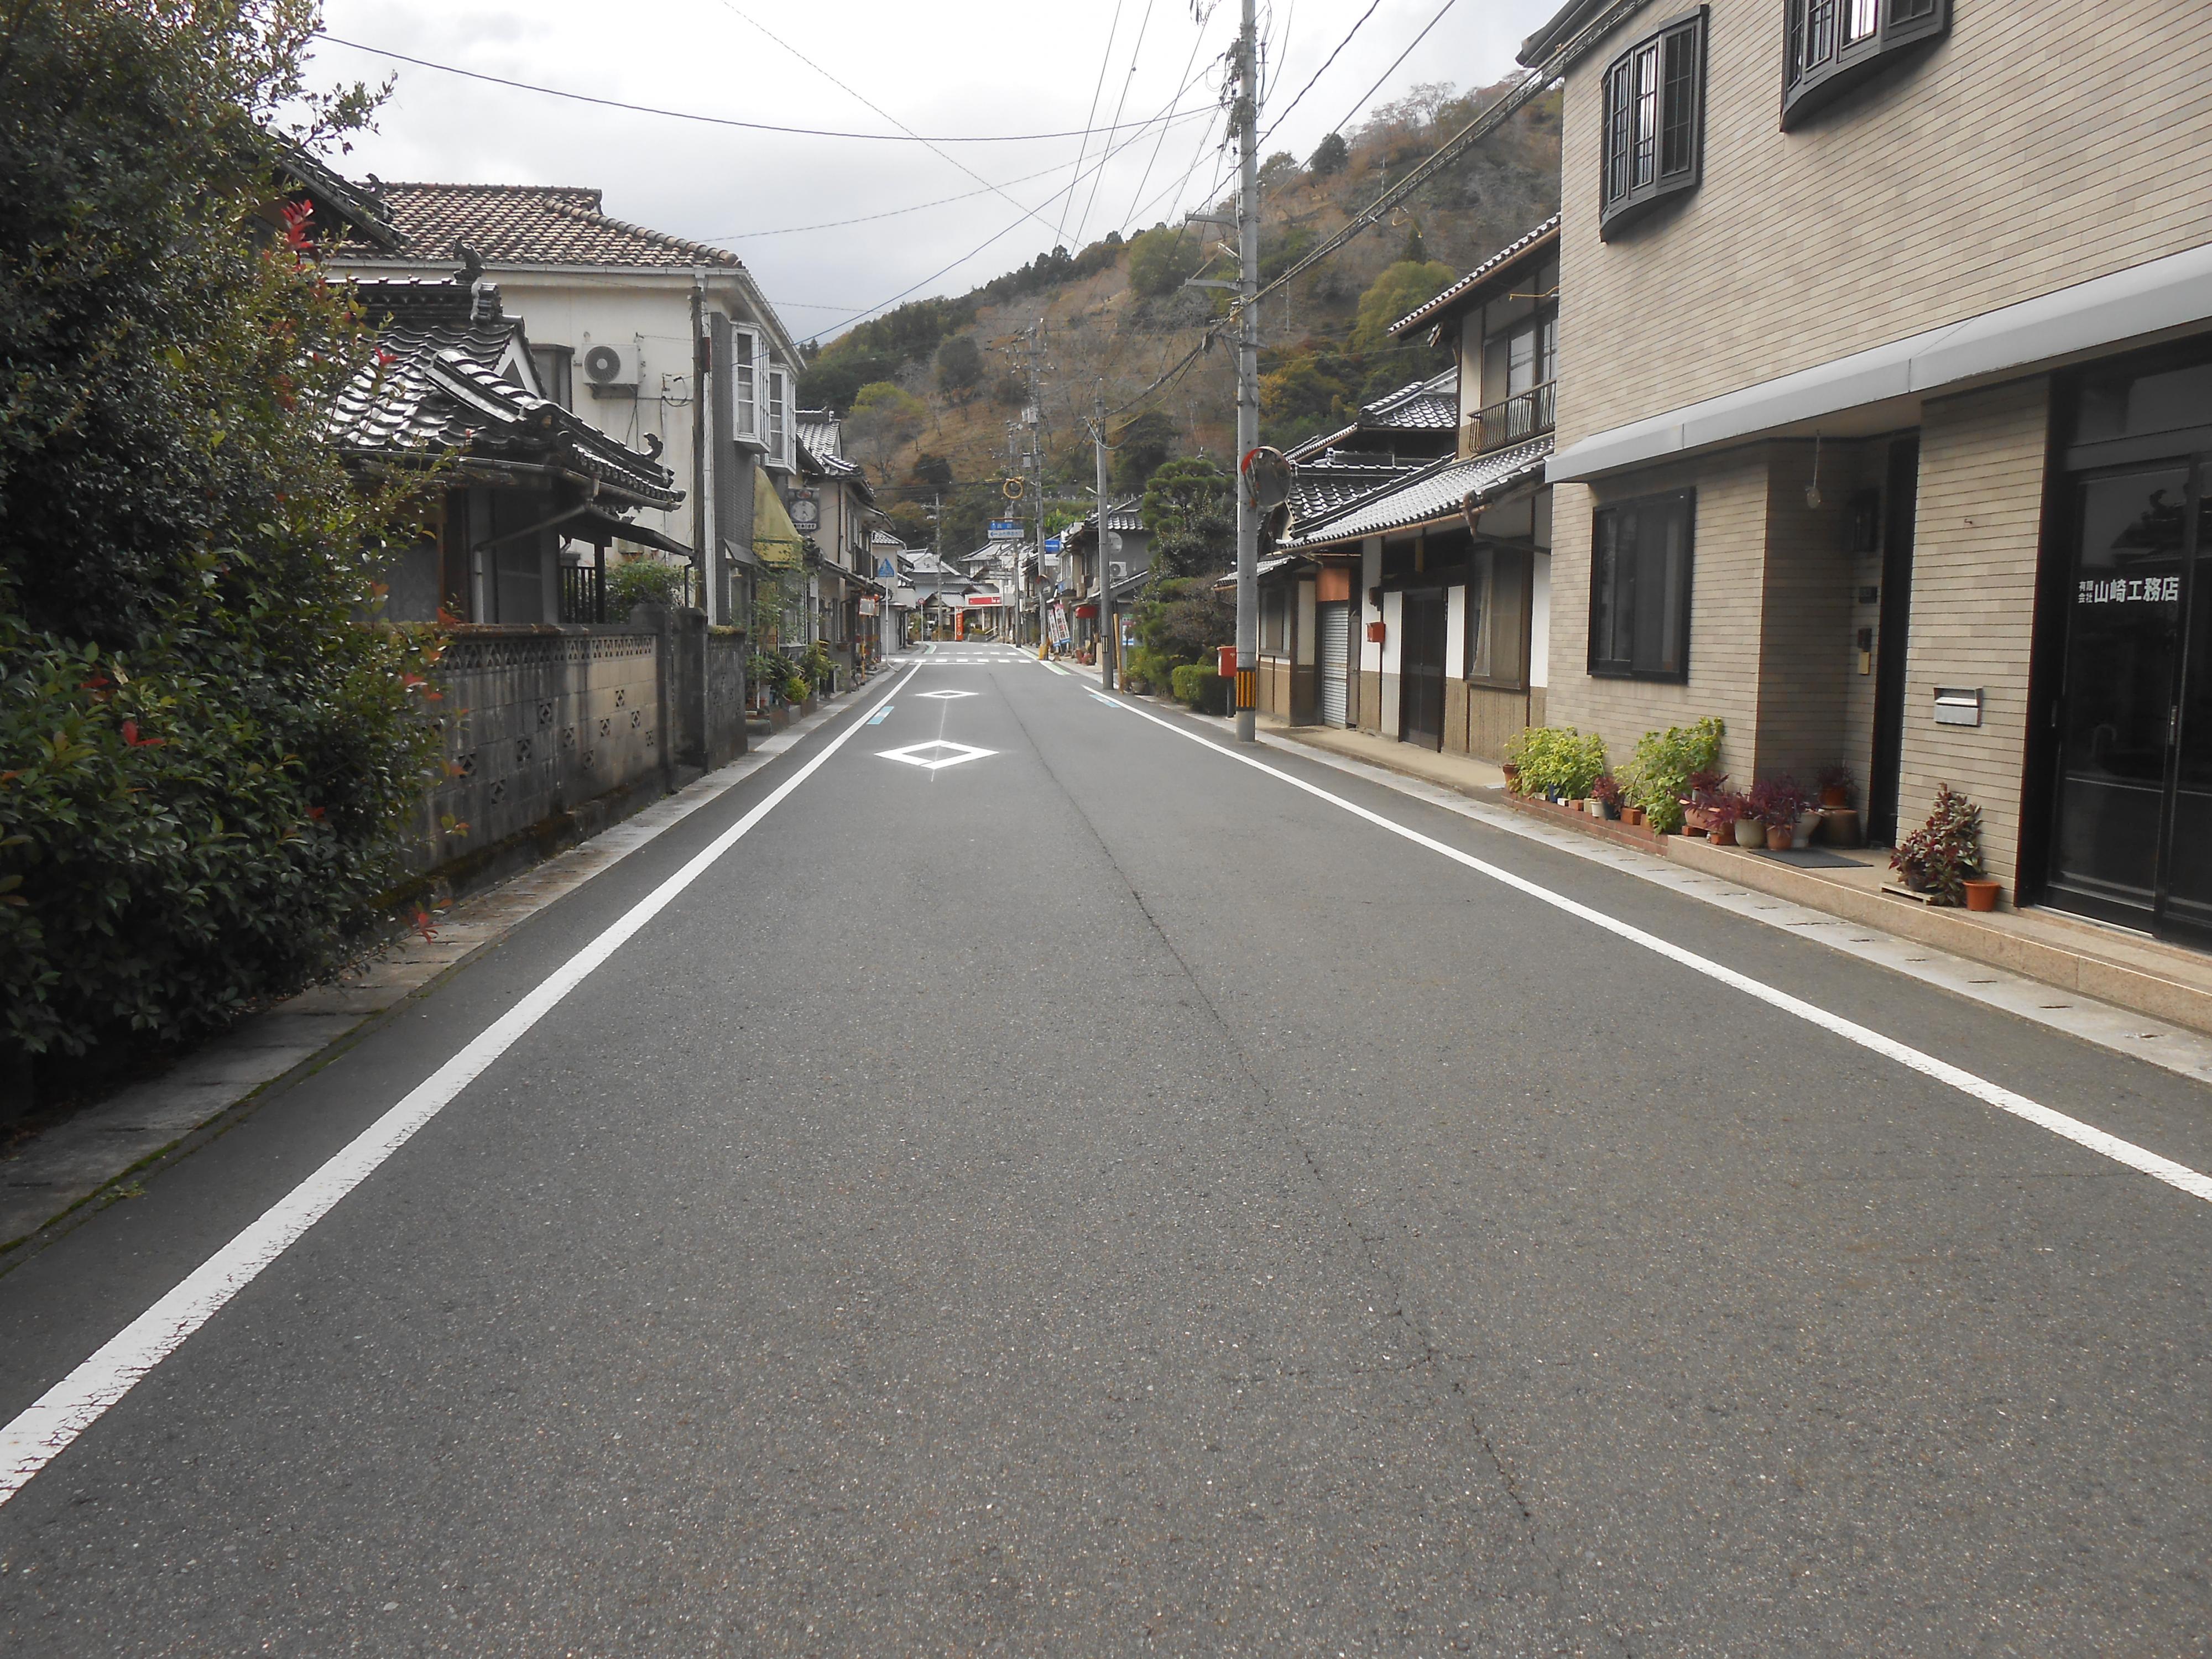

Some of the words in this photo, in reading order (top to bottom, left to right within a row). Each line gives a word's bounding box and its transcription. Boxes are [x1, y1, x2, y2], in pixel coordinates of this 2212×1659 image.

[2094, 577, 2179, 603] 山崎工務店
